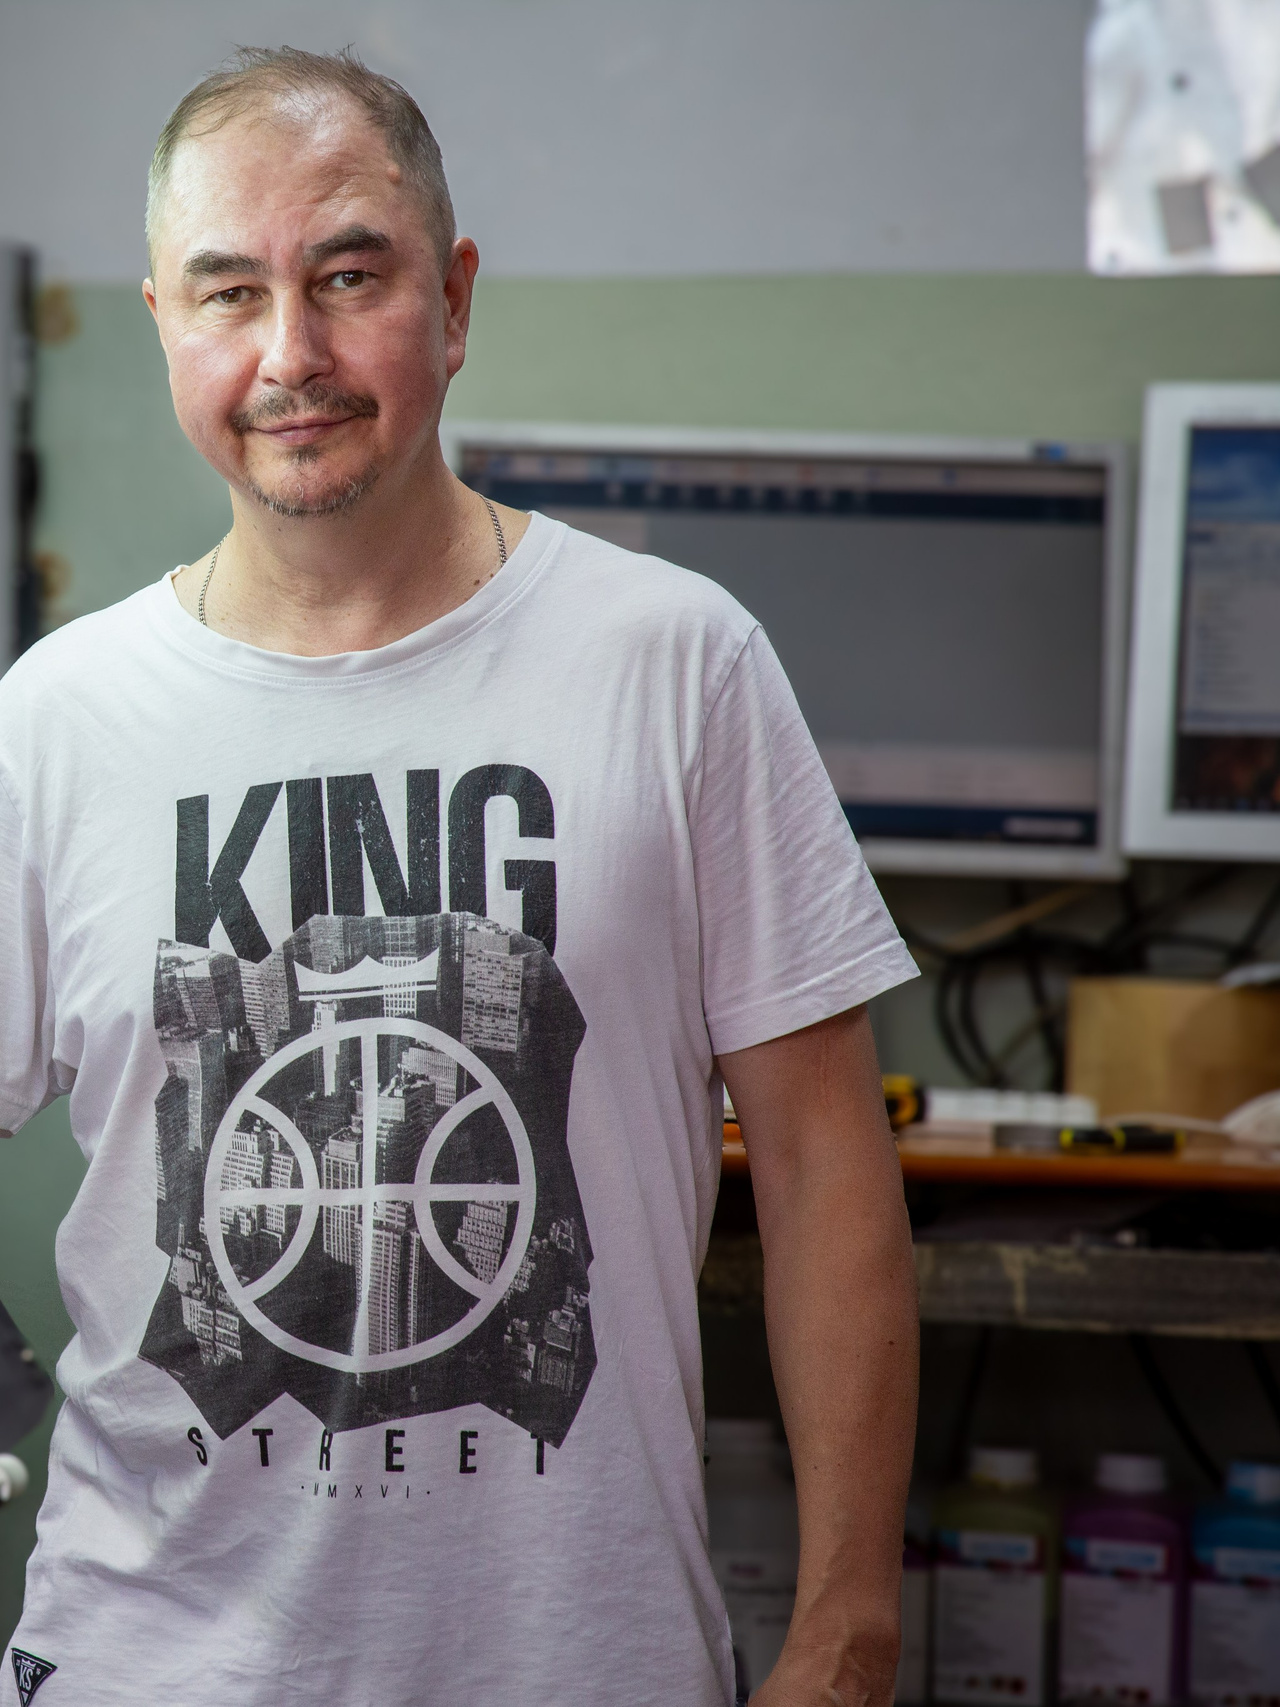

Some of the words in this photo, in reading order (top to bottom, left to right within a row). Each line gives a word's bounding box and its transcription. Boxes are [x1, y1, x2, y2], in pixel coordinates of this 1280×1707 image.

[174, 763, 557, 964] KING
[187, 1426, 545, 1475] STREET
[19, 1664, 34, 1691] KS
